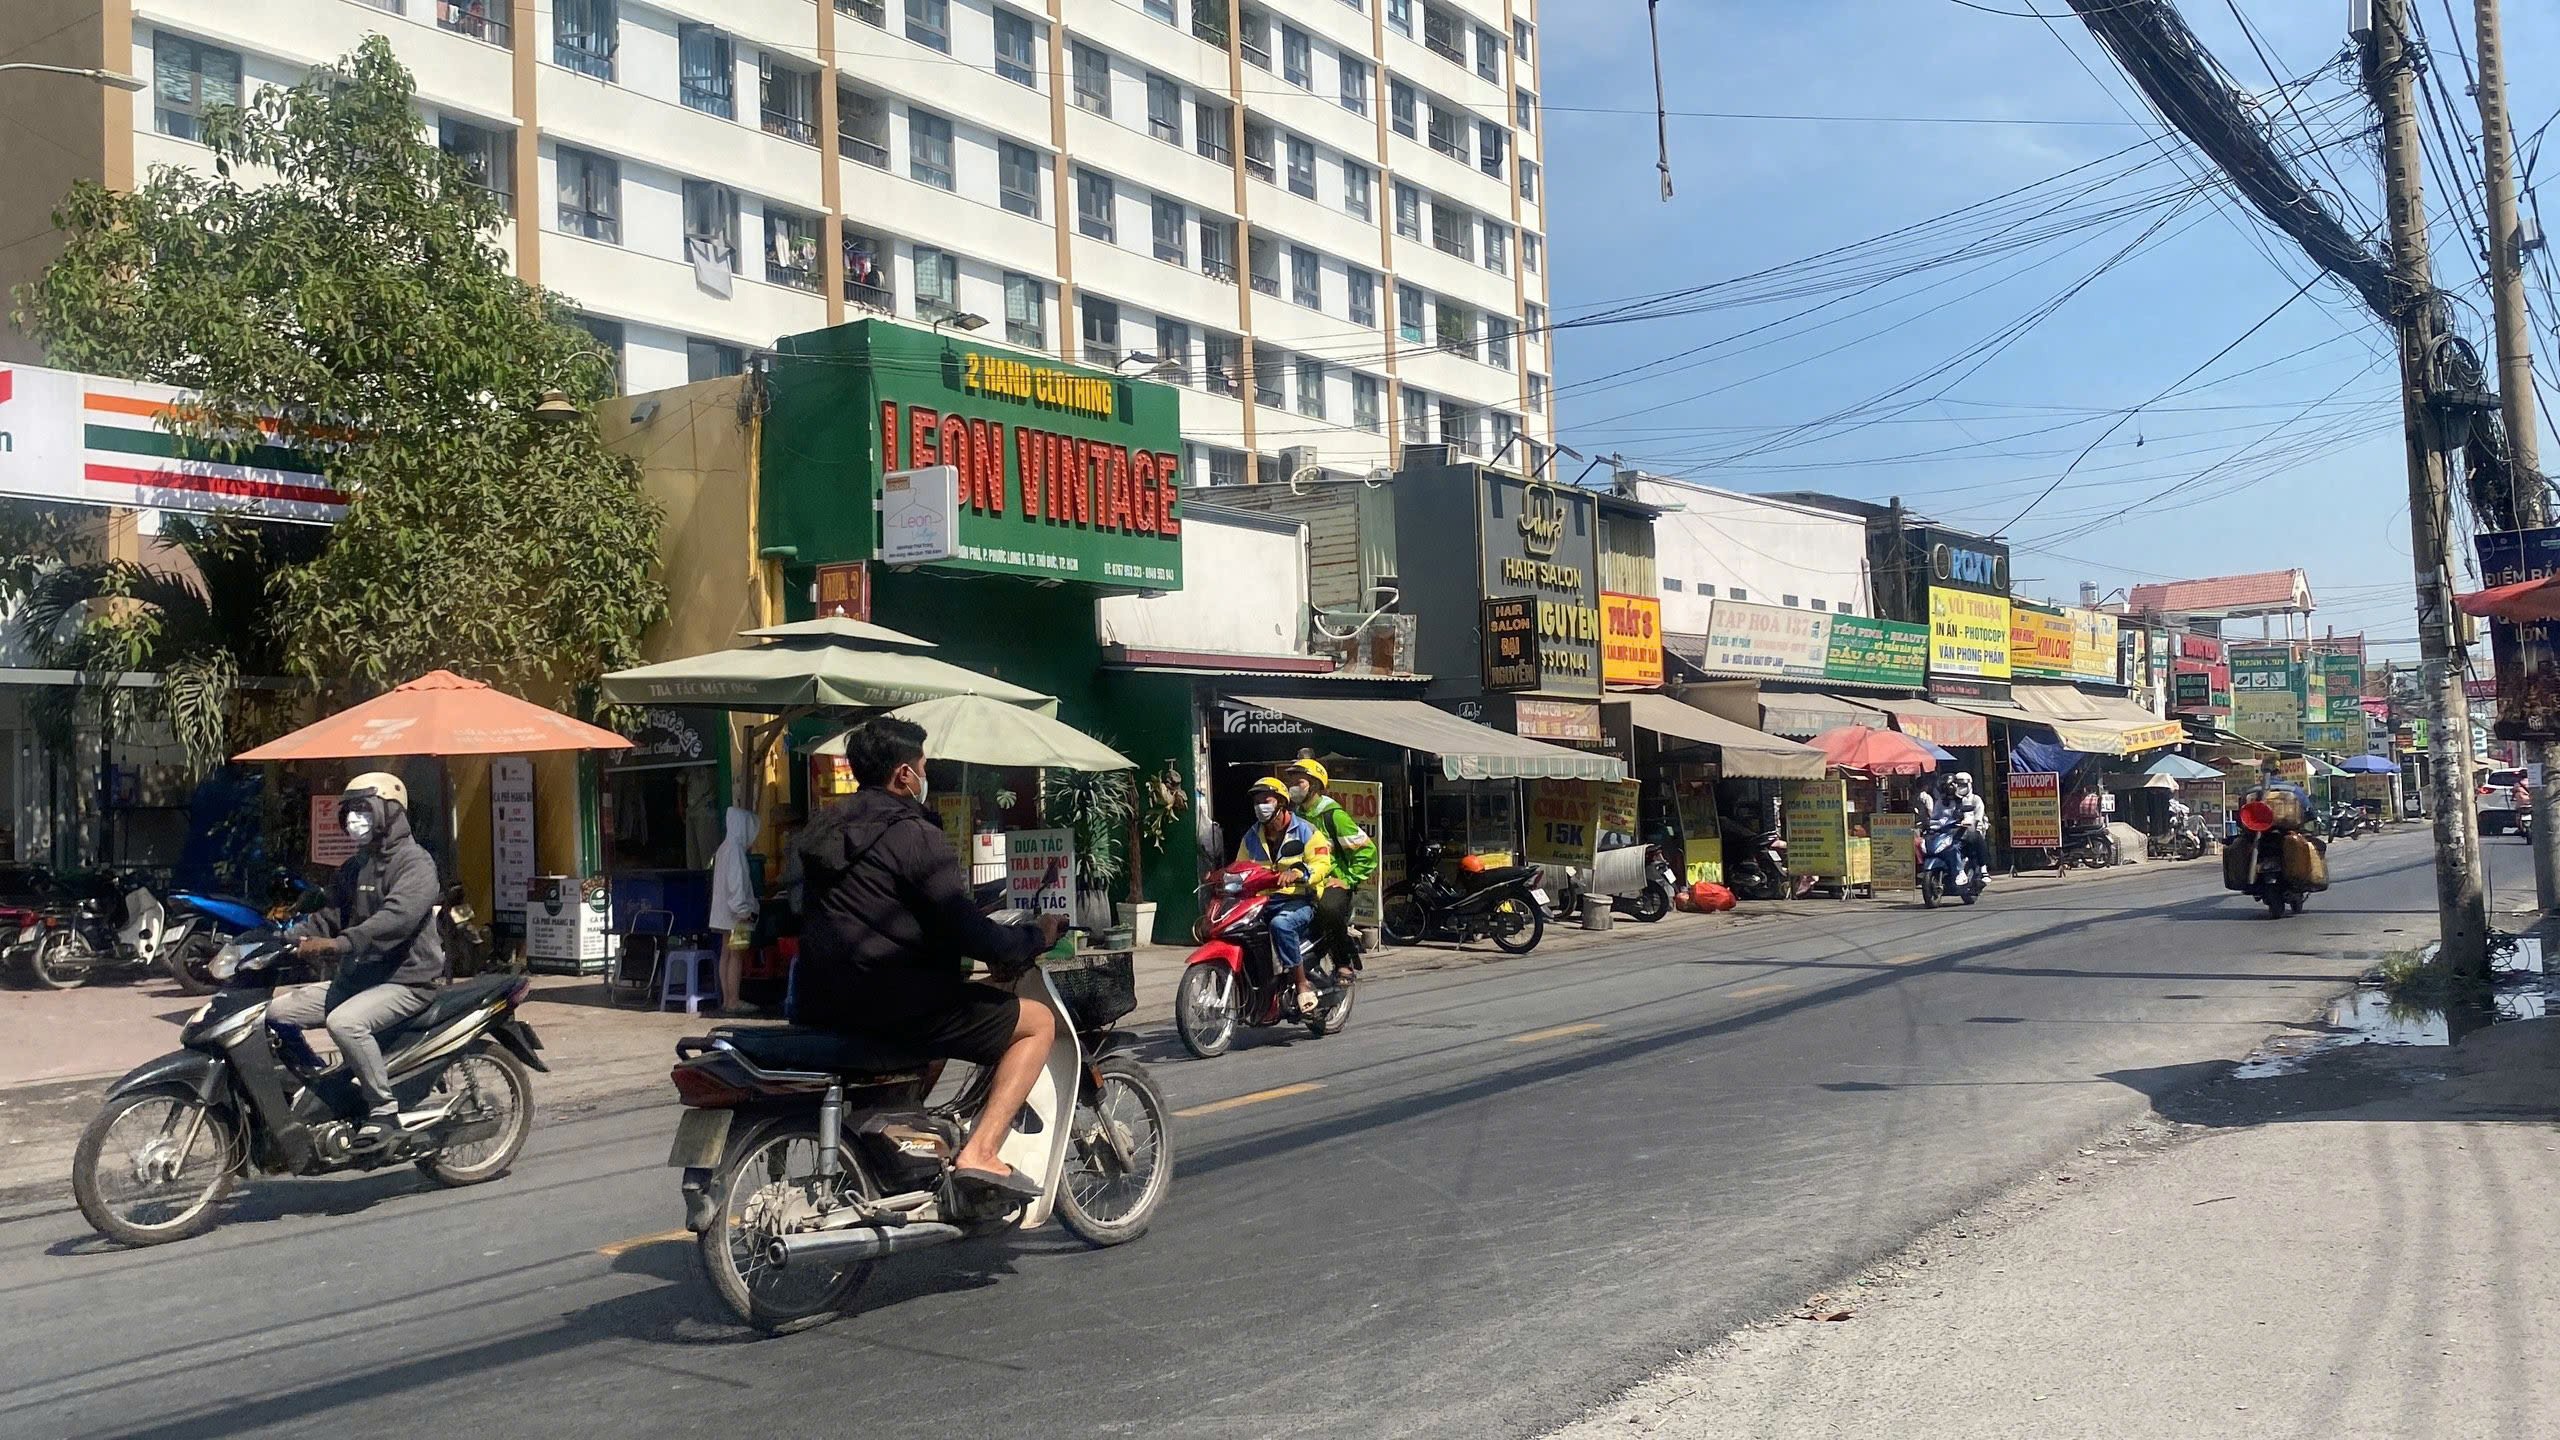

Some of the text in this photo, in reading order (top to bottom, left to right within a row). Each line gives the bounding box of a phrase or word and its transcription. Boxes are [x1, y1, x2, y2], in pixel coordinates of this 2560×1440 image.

[965, 352, 1112, 416] 2 HAND CLOTHING
[1015, 426, 1181, 535] VINTAGE
[901, 513, 932, 528] Leon
[1505, 558, 1582, 589] HAIR SALON
[1951, 547, 1993, 585] ROXY
[1495, 604, 1523, 618] HAIR
[1717, 608, 1746, 633] TẠP
[1490, 618, 1530, 632] SALON
[1936, 622, 1945, 636] IN
[1946, 618, 1957, 638] ẤN
[1964, 626, 2006, 644] PHOTOCOPY
[1939, 645, 2005, 665] VĂN PHÒNG PHẨM
[2037, 637, 2071, 660] KIM LONG
[1541, 649, 1591, 671] SSIONAL
[649, 683, 673, 697] TRÀ
[2010, 774, 2055, 788] PHOTOCOPY
[1352, 788, 1377, 818] BÒ
[1040, 832, 1063, 852] TẮC
[1544, 822, 1584, 847] 15K
[1013, 876, 1040, 890] CAM
[1042, 891, 1067, 909] TẮC
